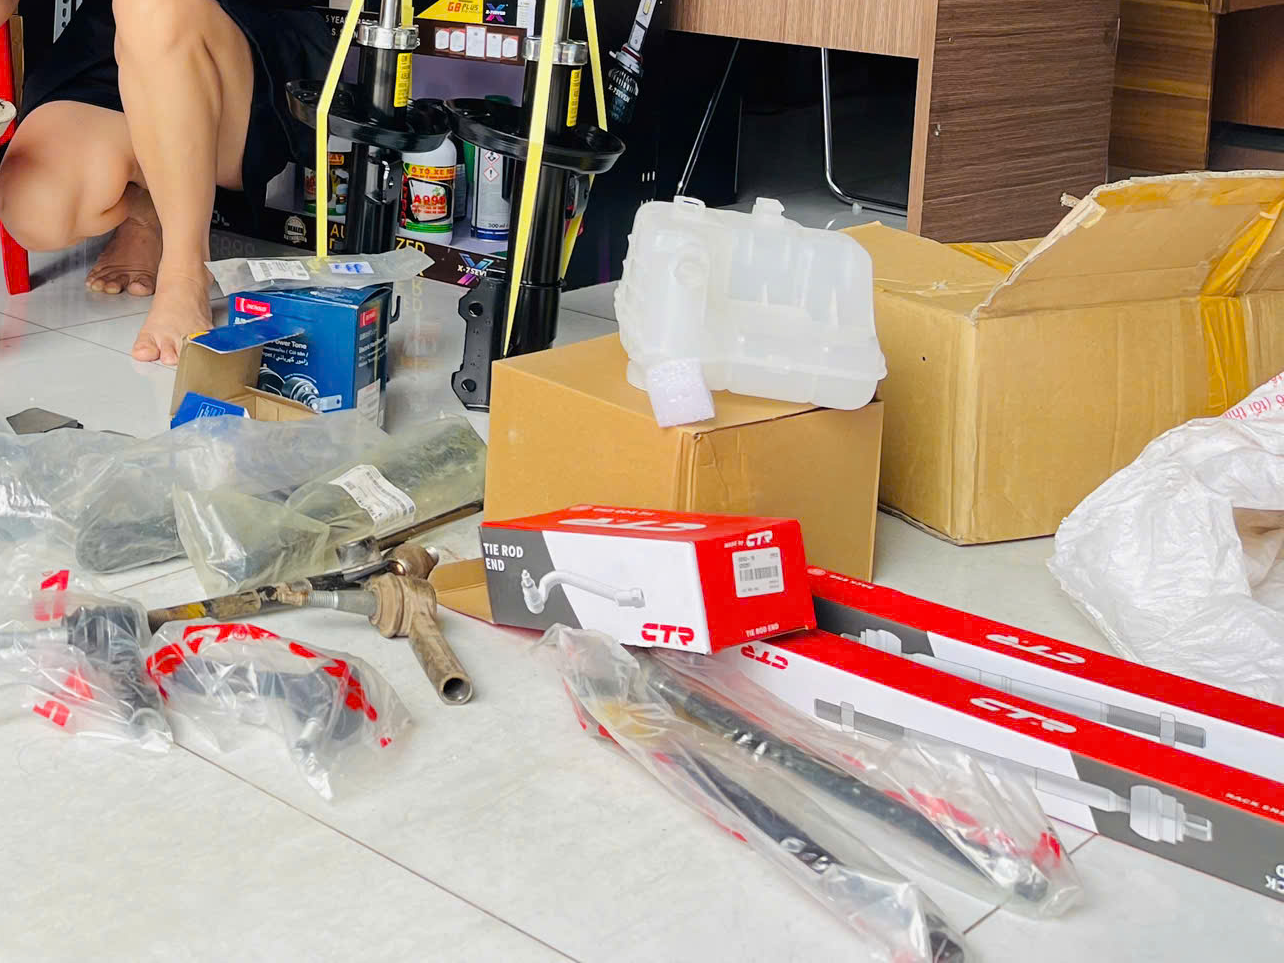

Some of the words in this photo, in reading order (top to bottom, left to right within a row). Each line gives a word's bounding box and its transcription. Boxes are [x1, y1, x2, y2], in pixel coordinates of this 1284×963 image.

[461, 3, 479, 11] PLUS
[331, 15, 346, 24] YEA
[457, 264, 487, 277] X-7SEV
[291, 341, 307, 349] Tone
[559, 516, 707, 533] CTR
[745, 530, 773, 547] CTR
[483, 542, 499, 556] TIE
[500, 544, 524, 558] ROD
[485, 558, 505, 572] END
[641, 623, 695, 646] CTR
[745, 629, 756, 638] TIE
[756, 626, 767, 636] ROD
[767, 623, 780, 633] END
[740, 644, 789, 670] CTR
[985, 633, 1086, 665] CTR
[970, 697, 1077, 734] CTR
